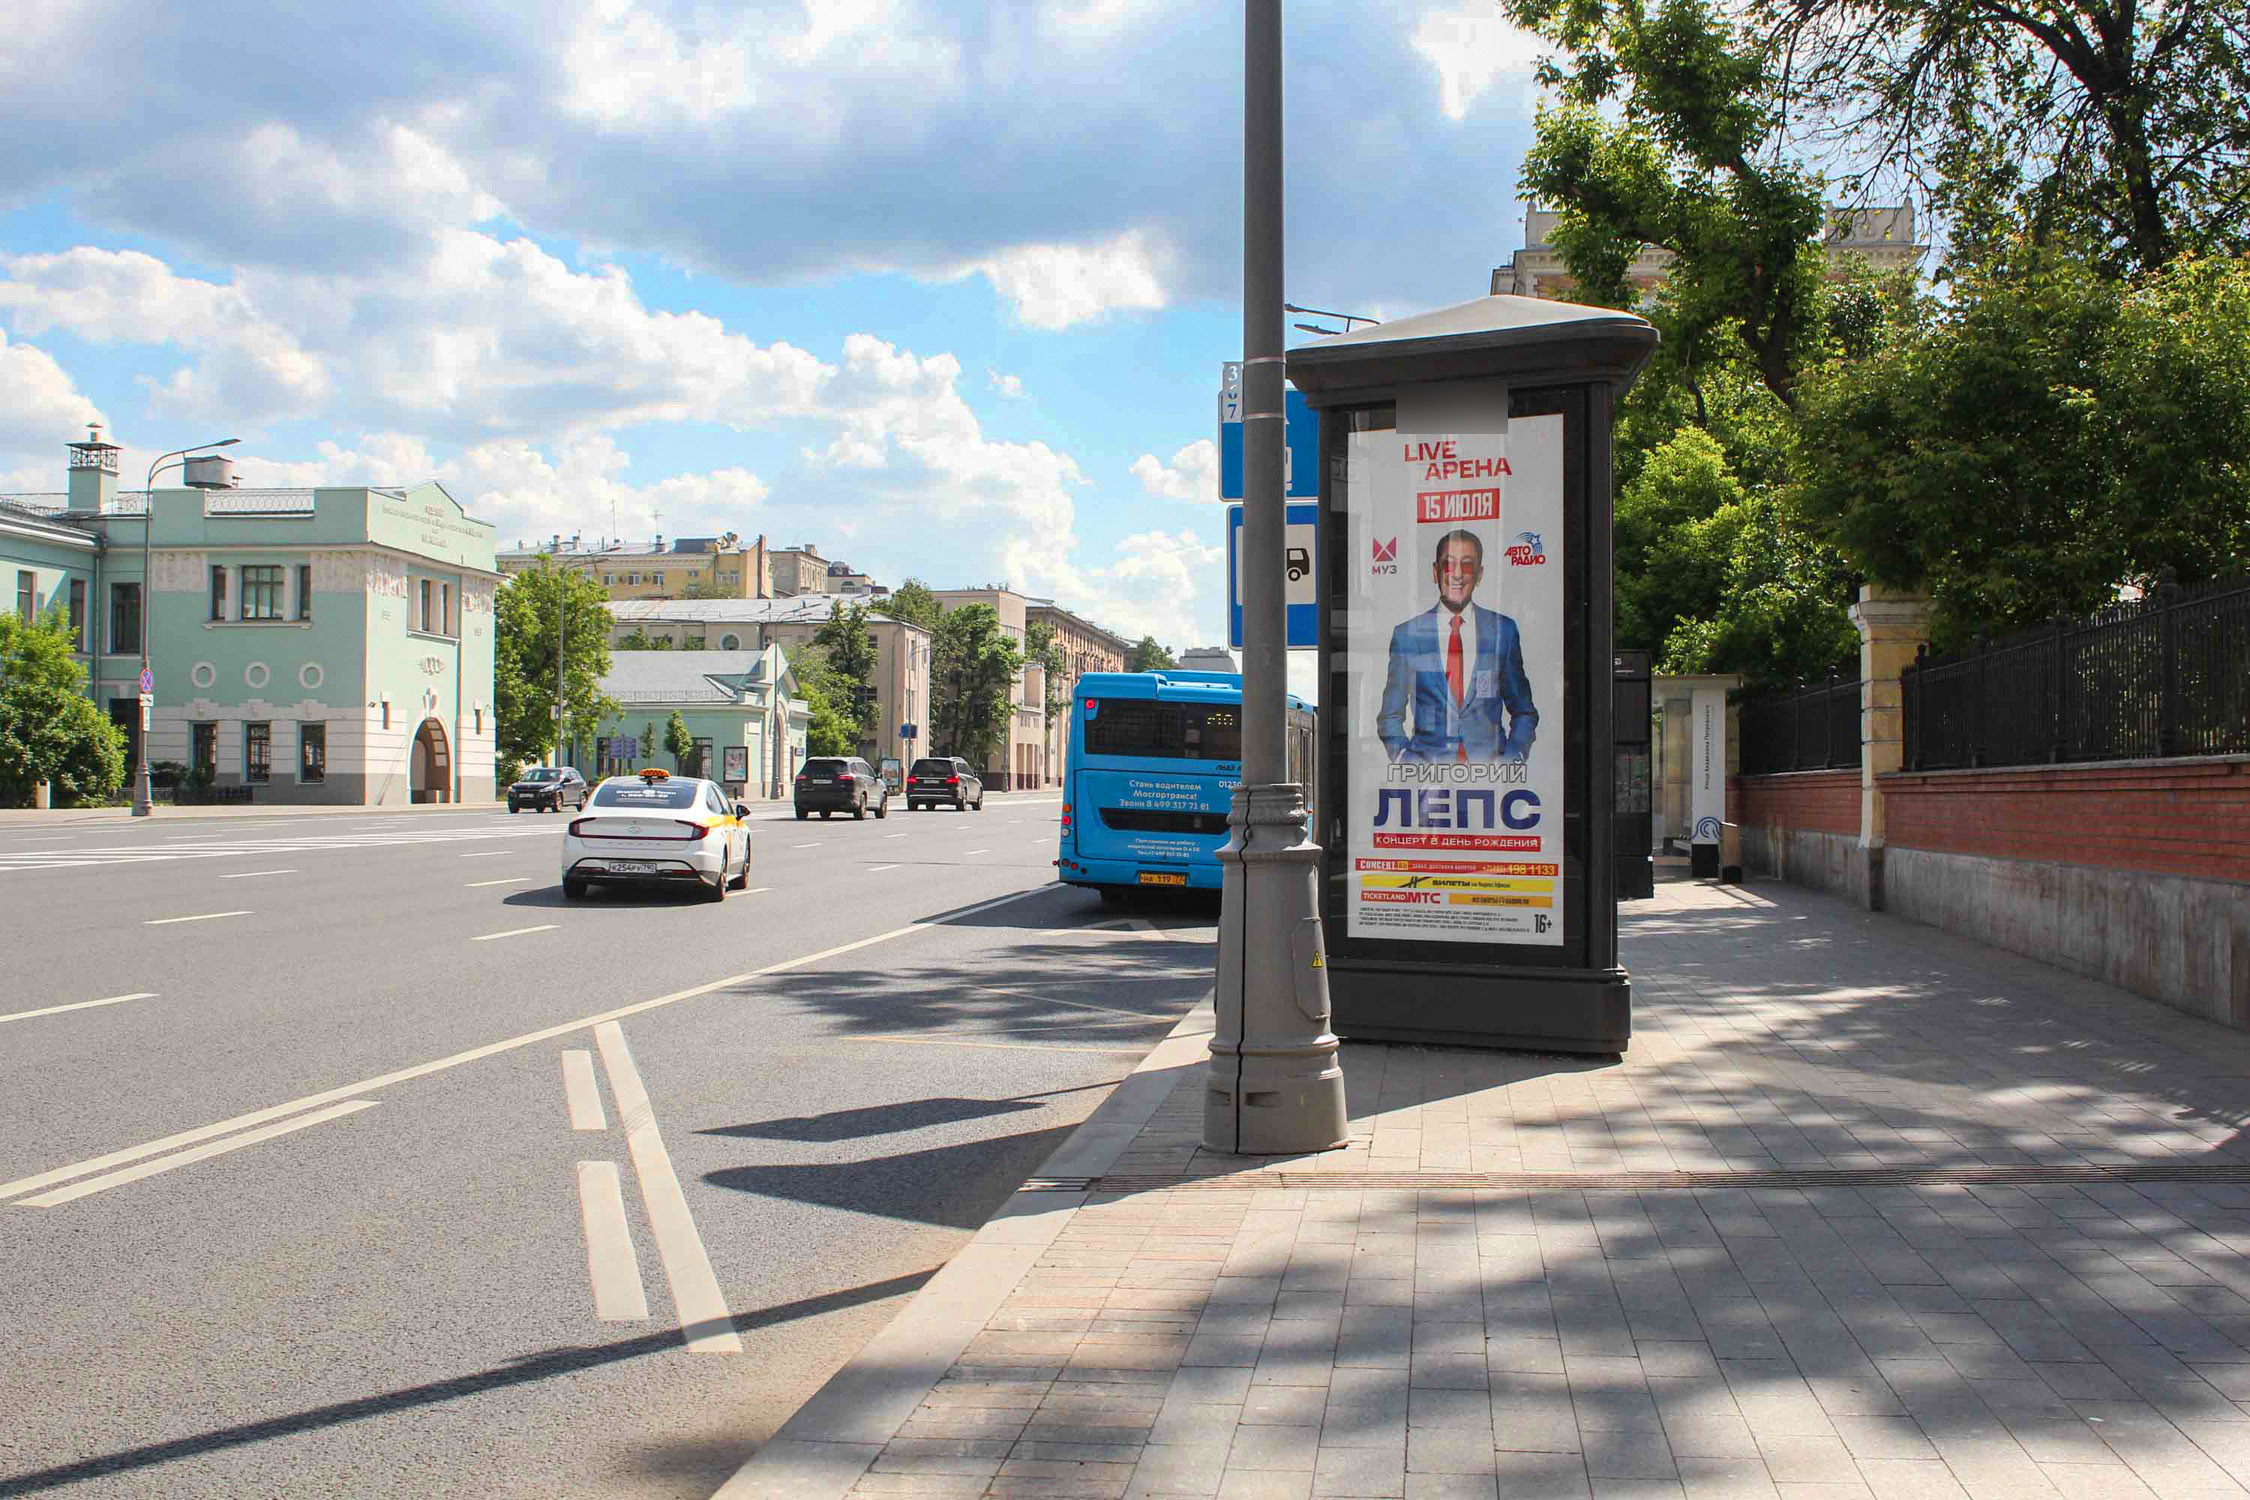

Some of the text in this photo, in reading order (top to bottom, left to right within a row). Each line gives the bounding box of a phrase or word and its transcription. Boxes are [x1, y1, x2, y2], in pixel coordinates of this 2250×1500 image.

[1404, 440, 1456, 462] LIVE
[1425, 458, 1512, 481] АРЕНА
[1424, 492, 1492, 519] 15 ИЮЛЯ
[1504, 545, 1531, 557] АВТО
[1511, 556, 1546, 566] РАДИО
[1372, 564, 1398, 575] МУЗ
[1387, 759, 1528, 783] ГРИГОРИЙ
[1129, 780, 1201, 791] Стань водителем
[1133, 790, 1197, 800] Мосгортранса!
[1119, 798, 1145, 807] Звони
[1374, 789, 1541, 830] ЛЕПС
[1376, 837, 1539, 848] КОНЦЕРТ В ДЕНЬ РОЖДЕНИЯ
[1432, 879, 1470, 888] БИЛЕТЫ
[1363, 891, 1440, 904] TICKETLAND МТС
[1534, 914, 1552, 934] 16+
